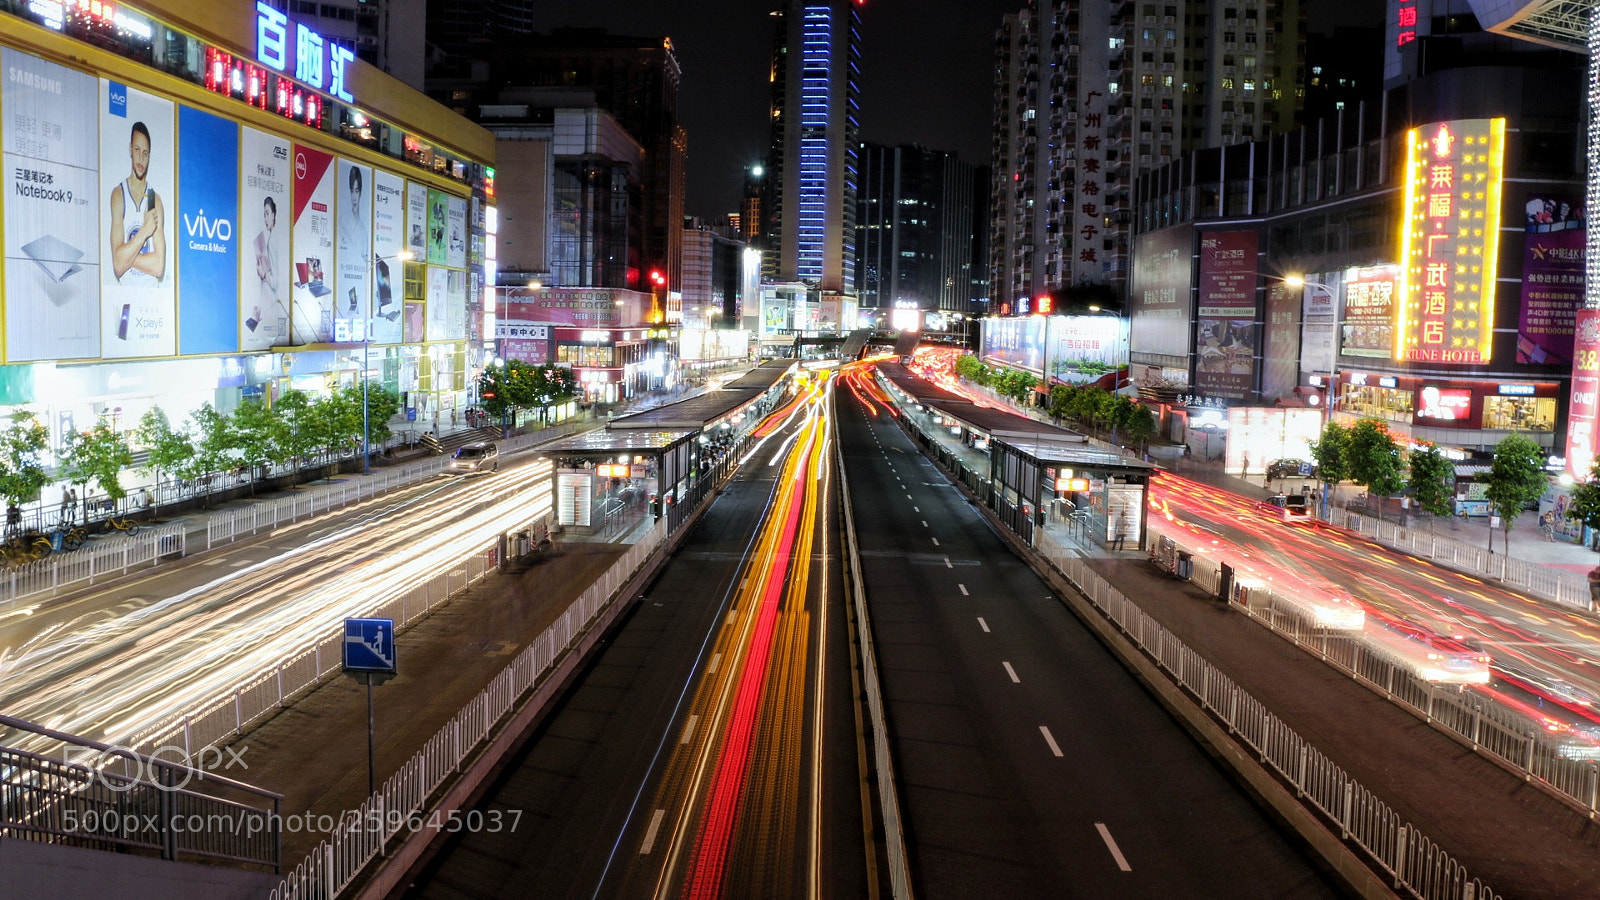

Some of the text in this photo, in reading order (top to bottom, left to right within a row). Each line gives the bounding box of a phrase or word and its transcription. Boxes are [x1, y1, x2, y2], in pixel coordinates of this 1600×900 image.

[257, 2, 354, 104] 百脑汇
[9, 67, 62, 95] SAMSUNG
[110, 92, 126, 103] vivo
[15, 168, 54, 185] 三星笔记本
[1080, 91, 1102, 263] 广州新赛格电子城
[15, 182, 66, 203] Notebook
[67, 191, 73, 203] 9
[184, 208, 232, 241] vivo
[189, 240, 208, 251] Camera
[213, 243, 227, 253] Music
[1442, 350, 1485, 362] HOTEL
[1440, 396, 1470, 407] KFC
